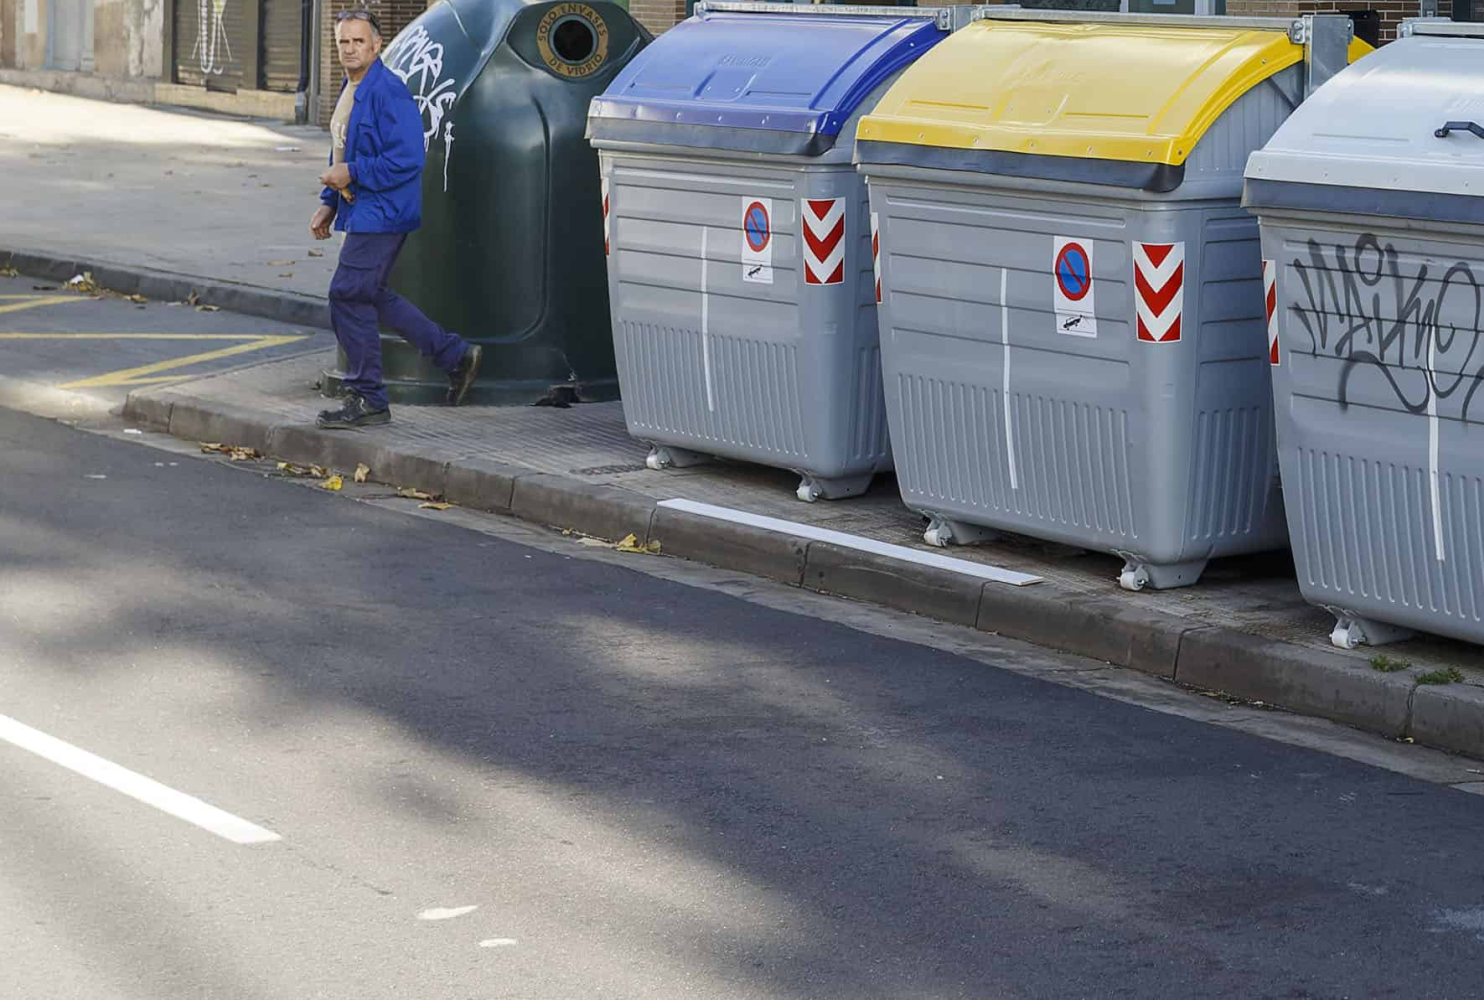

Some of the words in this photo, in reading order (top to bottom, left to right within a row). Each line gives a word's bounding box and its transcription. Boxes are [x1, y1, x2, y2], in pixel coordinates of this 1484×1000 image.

[538, 11, 557, 41] SOLO
[561, 3, 606, 36] ENVASES
[549, 58, 564, 72] DE
[567, 54, 603, 75] VIDRIO
